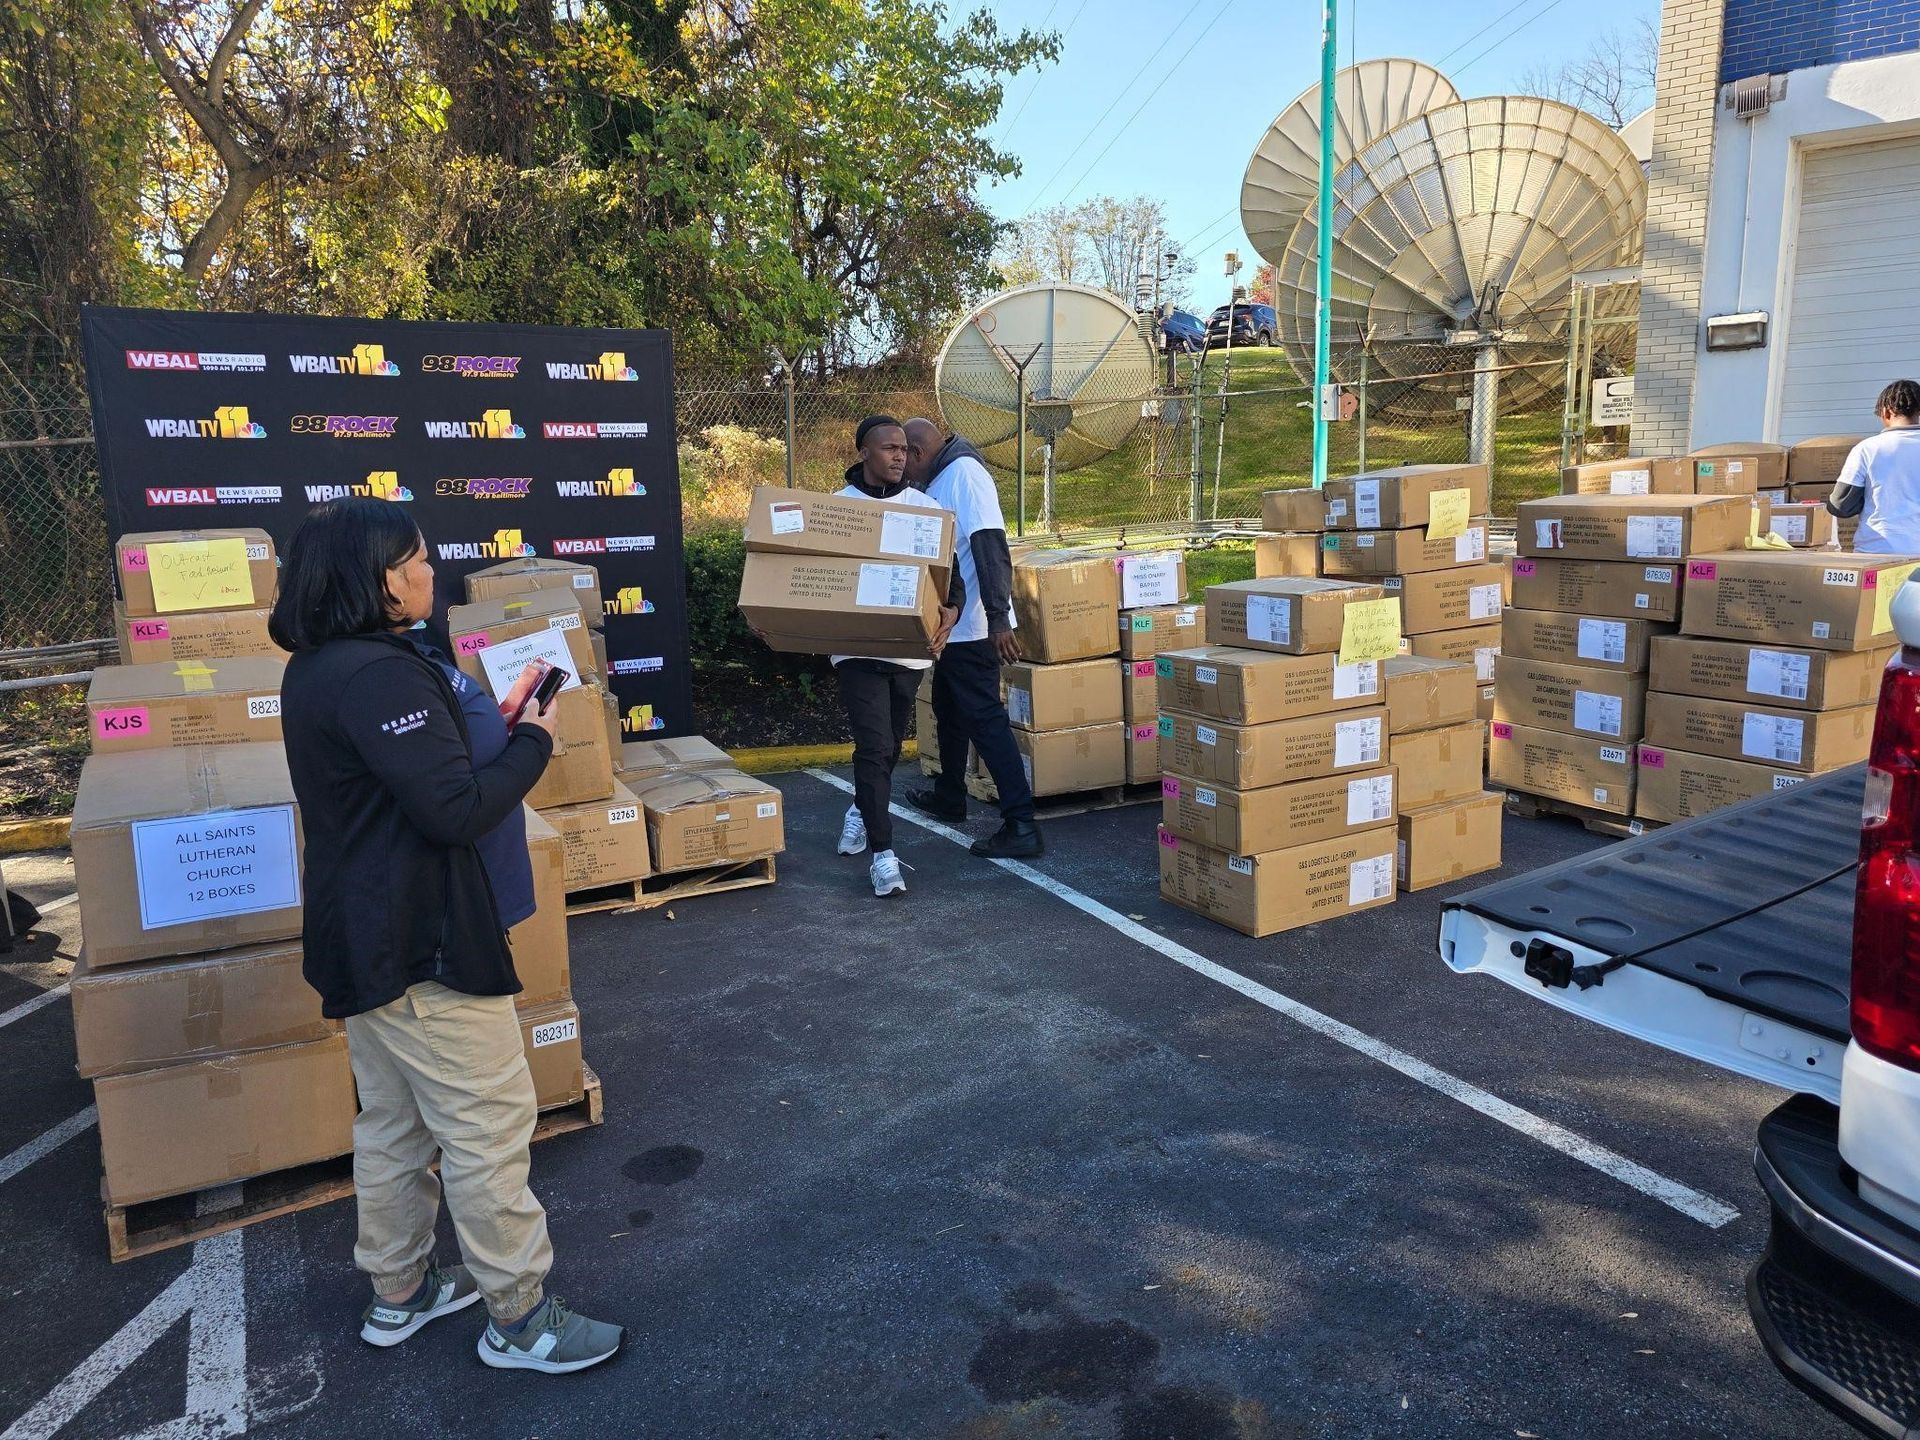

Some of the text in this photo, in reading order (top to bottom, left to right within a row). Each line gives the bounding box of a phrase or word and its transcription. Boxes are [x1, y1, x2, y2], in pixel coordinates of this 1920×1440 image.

[129, 352, 198, 369] WBAL
[201, 355, 264, 364] NEWSRADIO
[546, 424, 596, 437] WBAL
[148, 490, 215, 503] WBAL
[218, 488, 279, 496] NEWSRADIO
[825, 505, 855, 515] LOGISTICS
[822, 512, 846, 521] CAMPUS
[808, 526, 852, 538] UNITED STATES
[555, 541, 604, 553] WBAL
[608, 537, 654, 546] NEWSRADIO
[246, 547, 266, 558] 2317
[128, 556, 147, 565] KJ
[1517, 563, 1534, 573] KLF
[1691, 566, 1713, 576] KLF
[1826, 572, 1855, 583] 33043
[1865, 571, 1877, 584] KL
[1135, 620, 1150, 628] KLF
[136, 624, 164, 636] KLF
[462, 638, 486, 651] KJS
[513, 644, 534, 656] FORT
[616, 659, 662, 668] NEWSRADIO
[1137, 664, 1153, 674] KLF
[1159, 663, 1172, 673] KLF
[1296, 669, 1319, 677] LOGISTICS
[251, 700, 280, 714] 8823
[104, 716, 142, 730] KJS
[381, 709, 428, 731] HEARST
[394, 720, 426, 735] television
[1159, 721, 1172, 731] KLF
[1494, 727, 1510, 736] KLF
[1136, 727, 1152, 738] KLF
[1602, 750, 1623, 760] 32671
[1642, 754, 1661, 764] KLF
[1163, 783, 1178, 794] KLF
[1301, 793, 1325, 802] LOGISTICS
[611, 809, 635, 821] 32763
[176, 825, 256, 845] ALL SAINTS
[1161, 833, 1176, 845] KLF
[179, 844, 256, 864] LUTHERAN
[1231, 857, 1250, 872] 32671
[187, 863, 252, 882] CHURCH
[188, 883, 256, 903] 12 BOXES
[535, 1022, 575, 1044] 882317
